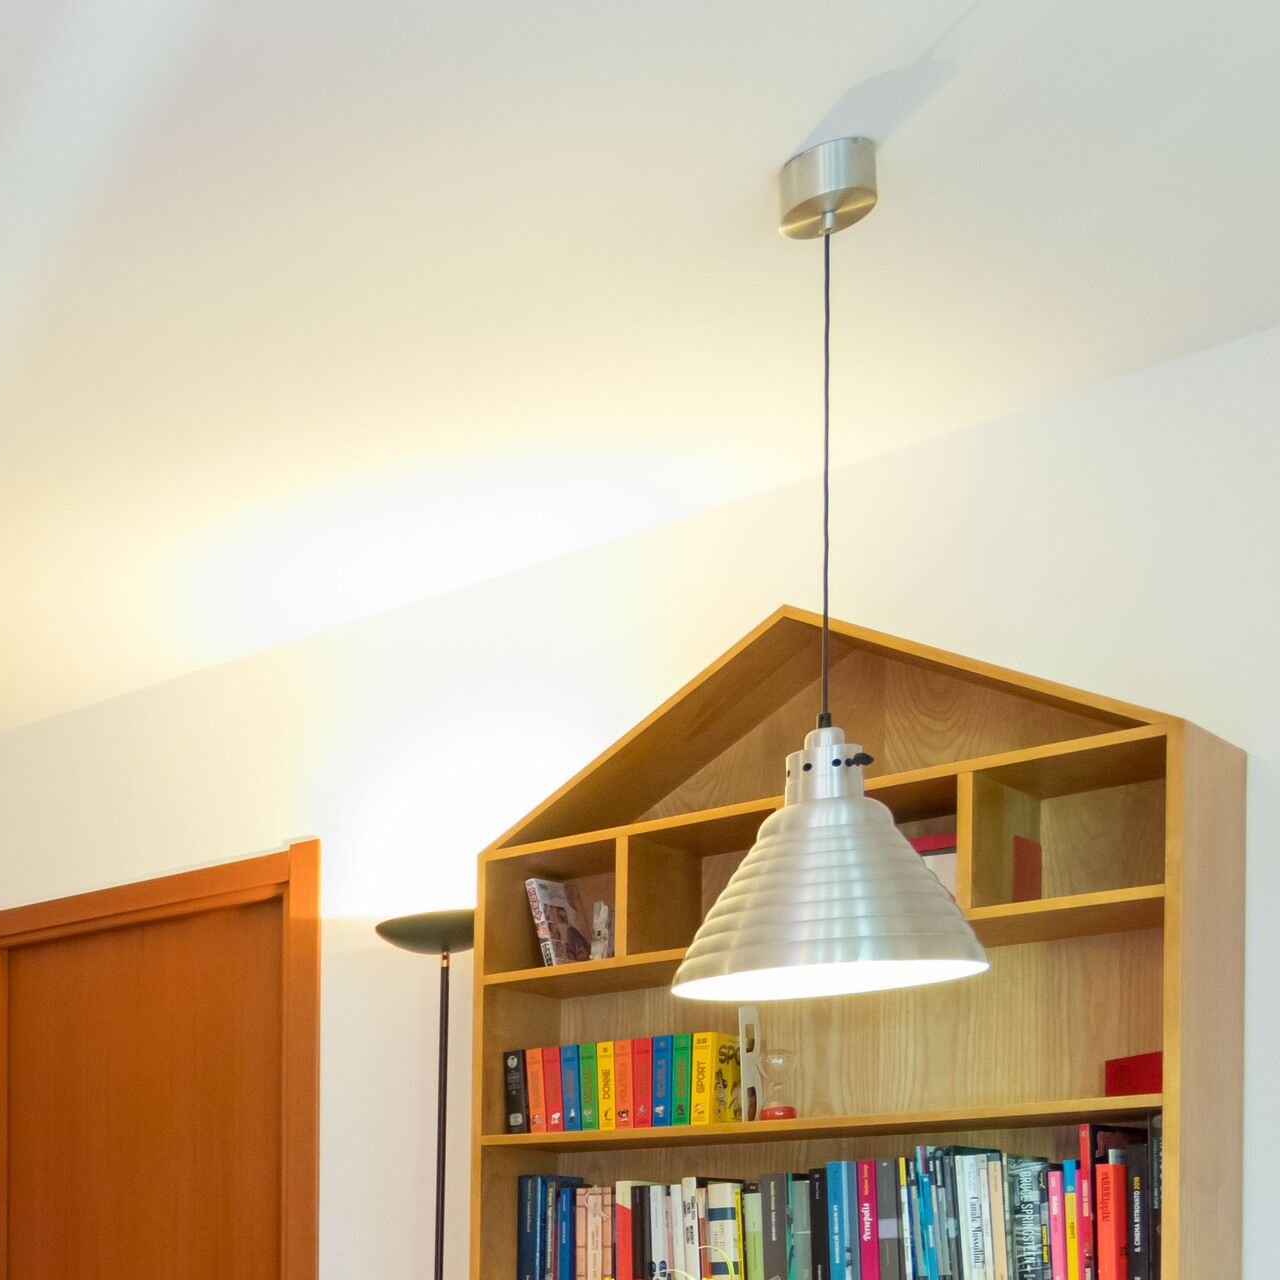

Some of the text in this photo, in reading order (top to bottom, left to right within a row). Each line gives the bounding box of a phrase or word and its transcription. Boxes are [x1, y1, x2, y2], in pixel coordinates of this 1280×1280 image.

[602, 1068, 611, 1100] DONNE
[697, 1061, 707, 1094] SPORT
[861, 1202, 874, 1242] Persepolis
[969, 1196, 985, 1265] Canale Mussolini
[1019, 1170, 1036, 1267] BRUCE SPRINGSTEEN
